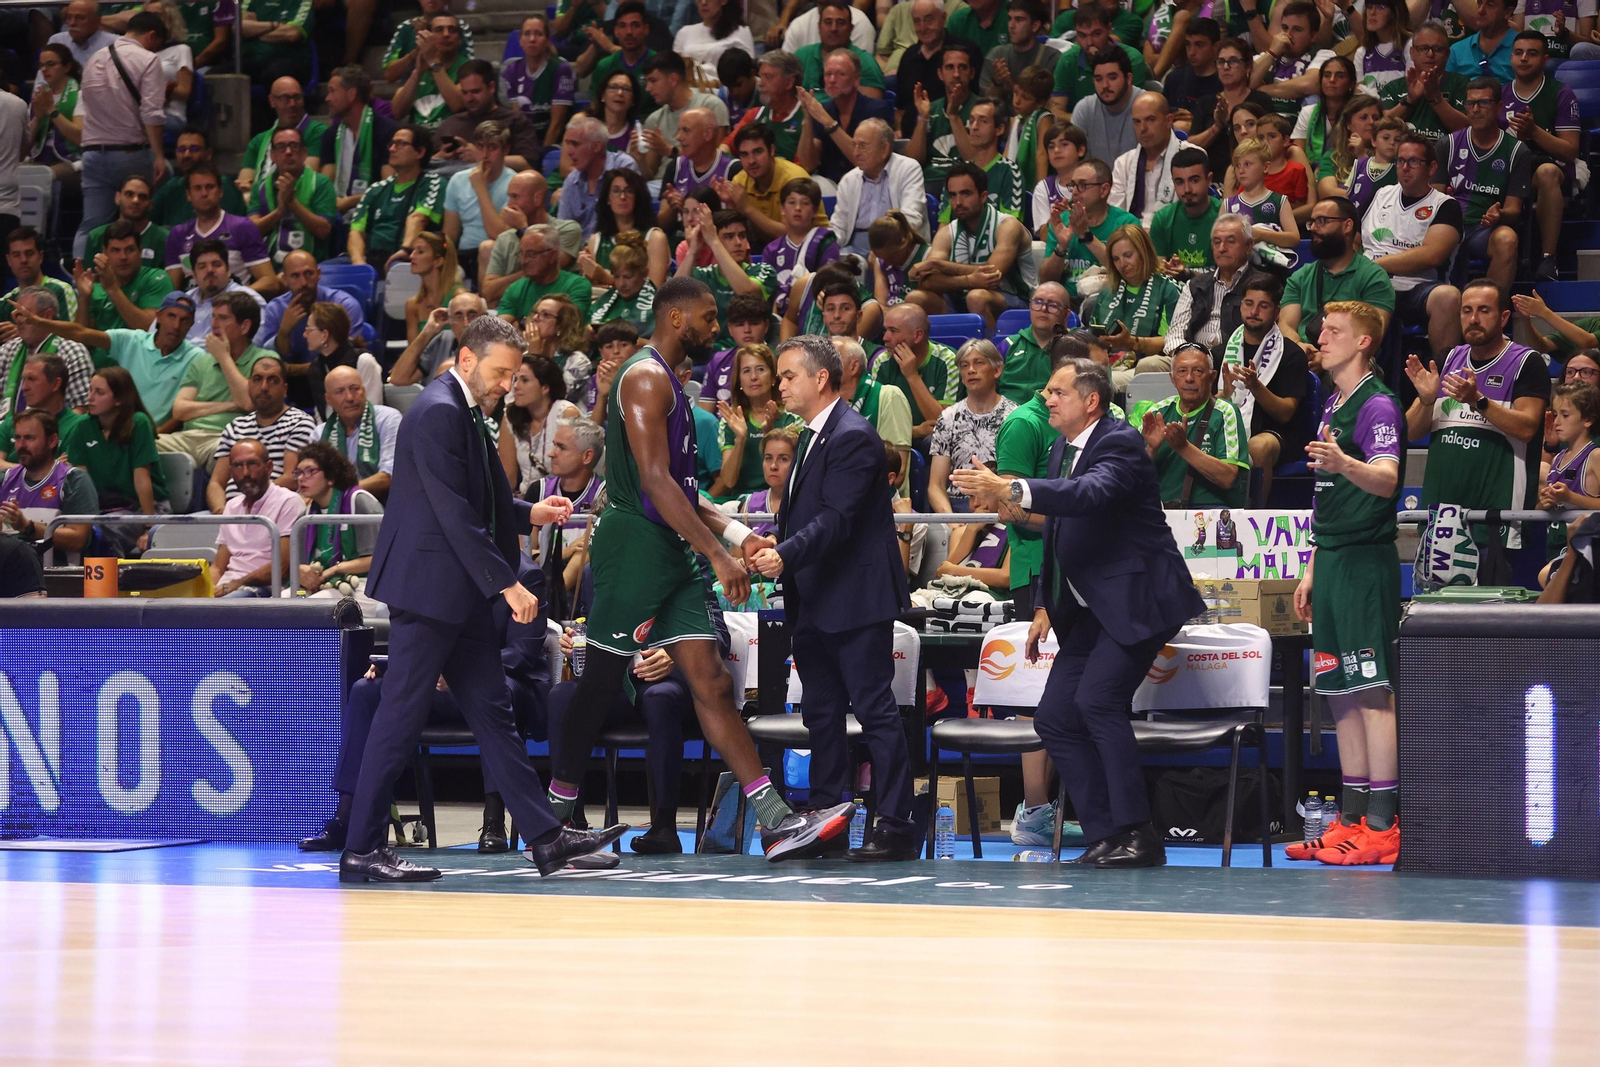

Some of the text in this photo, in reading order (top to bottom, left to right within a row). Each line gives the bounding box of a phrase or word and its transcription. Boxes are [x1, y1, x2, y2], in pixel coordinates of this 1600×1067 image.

[1465, 180, 1500, 195] Unicaja
[1187, 650, 1262, 662] COSTA DEL SOL
[1187, 662, 1228, 671] MÁLAGA
[0, 670, 254, 815] NOS
